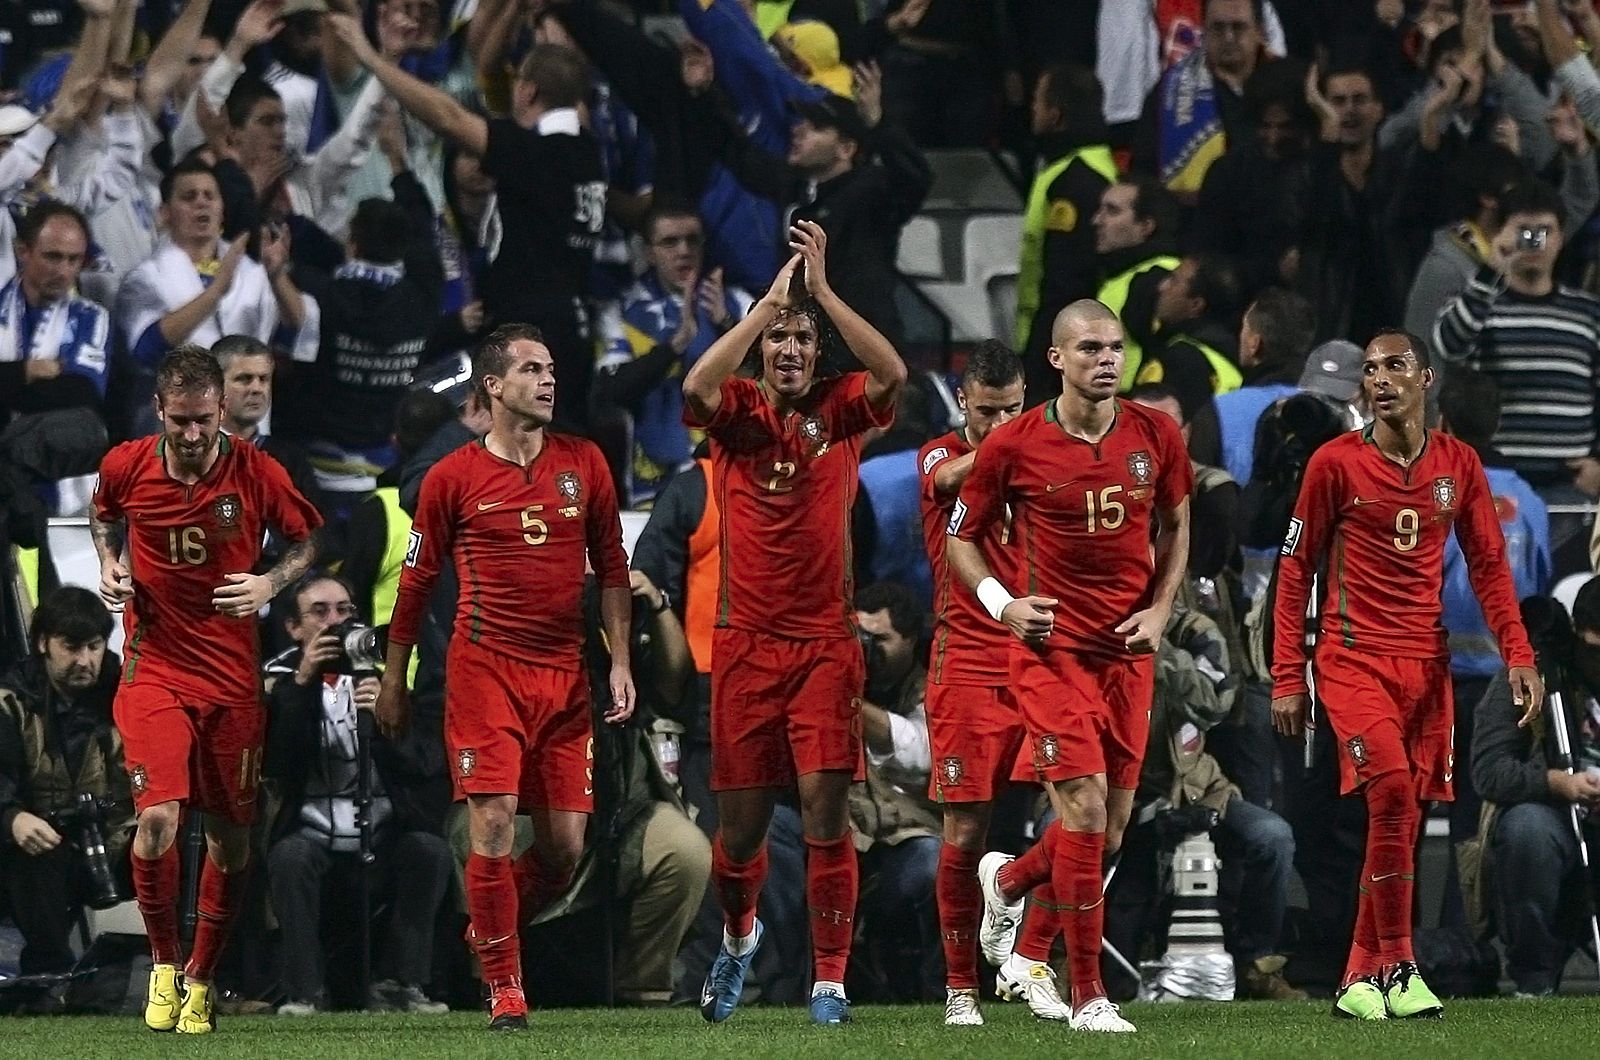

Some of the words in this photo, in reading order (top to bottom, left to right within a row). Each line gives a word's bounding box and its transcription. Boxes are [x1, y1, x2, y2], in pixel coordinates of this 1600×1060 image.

[767, 460, 796, 491] 2
[520, 504, 548, 546] 5
[1085, 484, 1126, 533] 15
[1392, 507, 1419, 552] 9
[168, 526, 207, 565] 16
